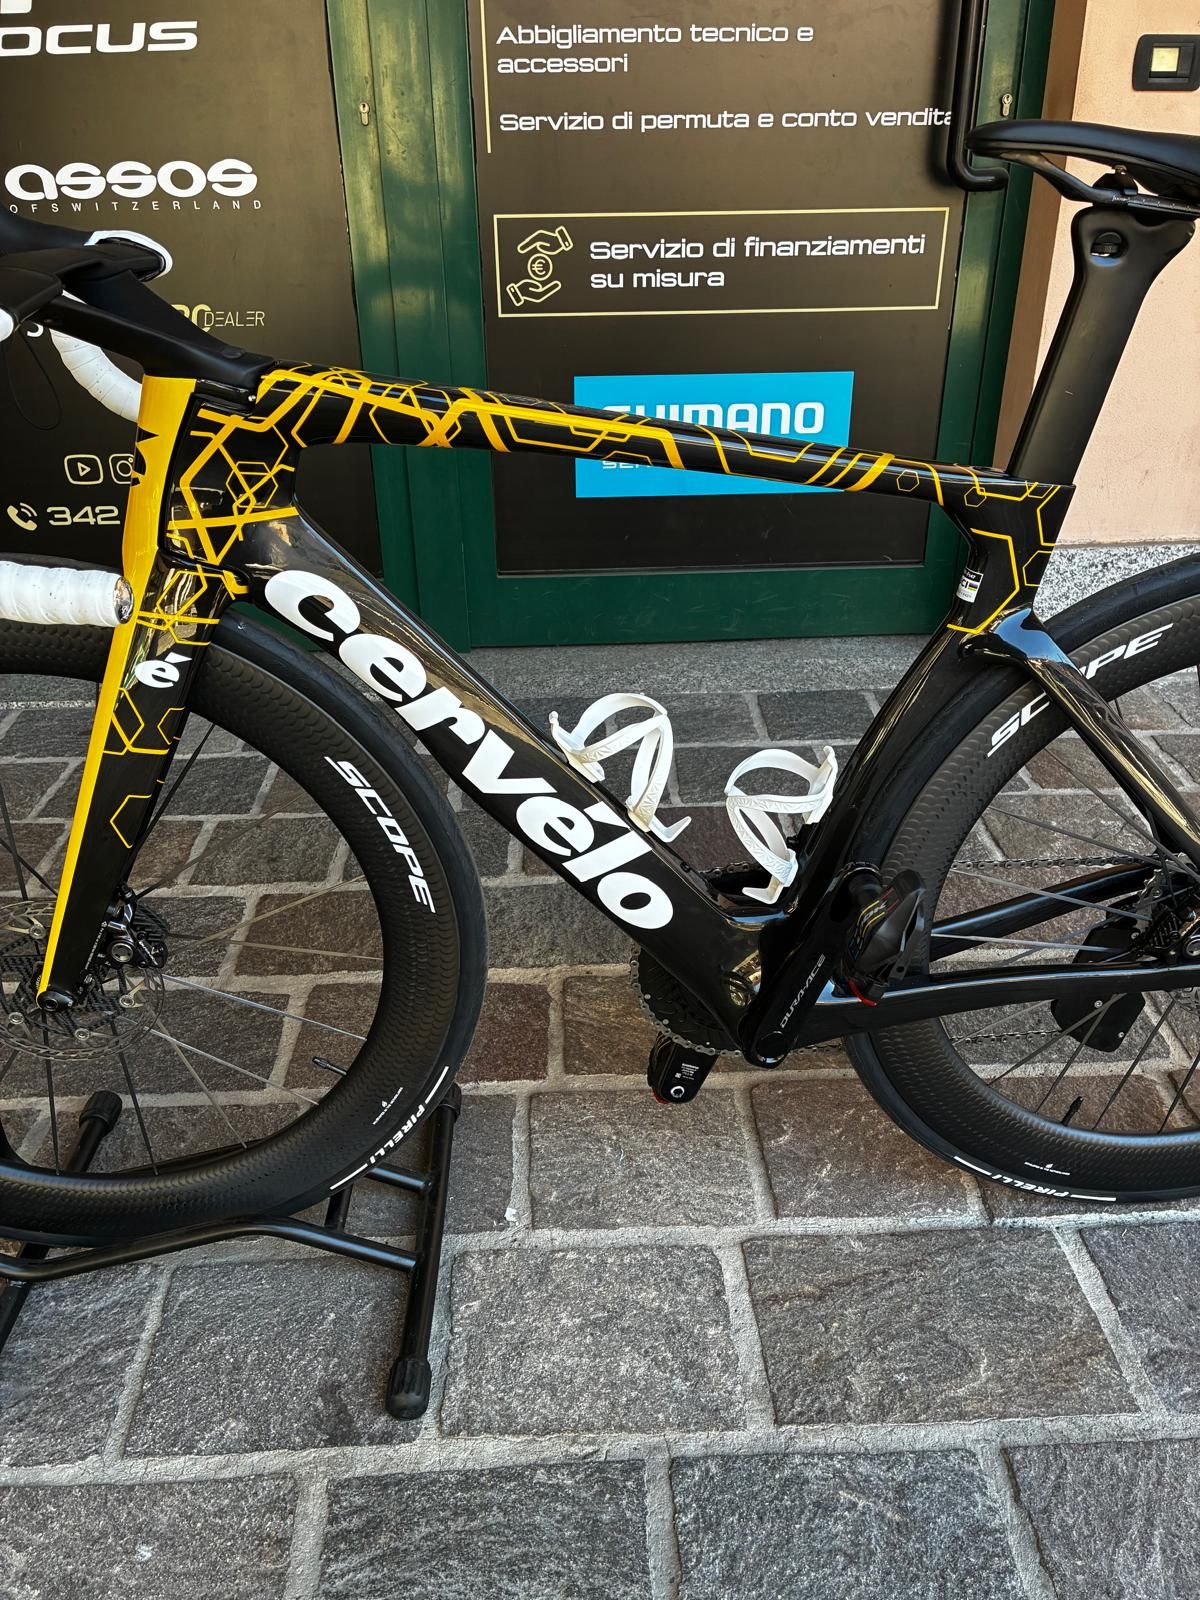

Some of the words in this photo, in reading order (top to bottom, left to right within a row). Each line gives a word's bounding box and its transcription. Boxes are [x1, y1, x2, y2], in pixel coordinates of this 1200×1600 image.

[496, 24, 682, 49] Abbigliamento
[690, 23, 789, 43] tecnico
[796, 26, 814, 42] e
[497, 53, 628, 74] accessori
[499, 111, 604, 132] Servizio
[612, 111, 633, 130] di
[641, 110, 750, 133] permuta
[757, 113, 774, 128] e
[781, 109, 858, 128] conto
[590, 239, 704, 260] Servizio
[712, 237, 736, 258] di
[744, 234, 926, 258] finanziamenti
[590, 273, 625, 289] su
[633, 269, 725, 288] misura
[204, 311, 265, 327] DEALER
[46, 505, 121, 526] 342
[987, 622, 1174, 758] SCPE
[324, 756, 436, 913] SCOPE
[780, 953, 826, 1029] DURA-ACE
[370, 1103, 425, 1164] PIRELLI
[991, 1174, 1070, 1198] PIRELLI
